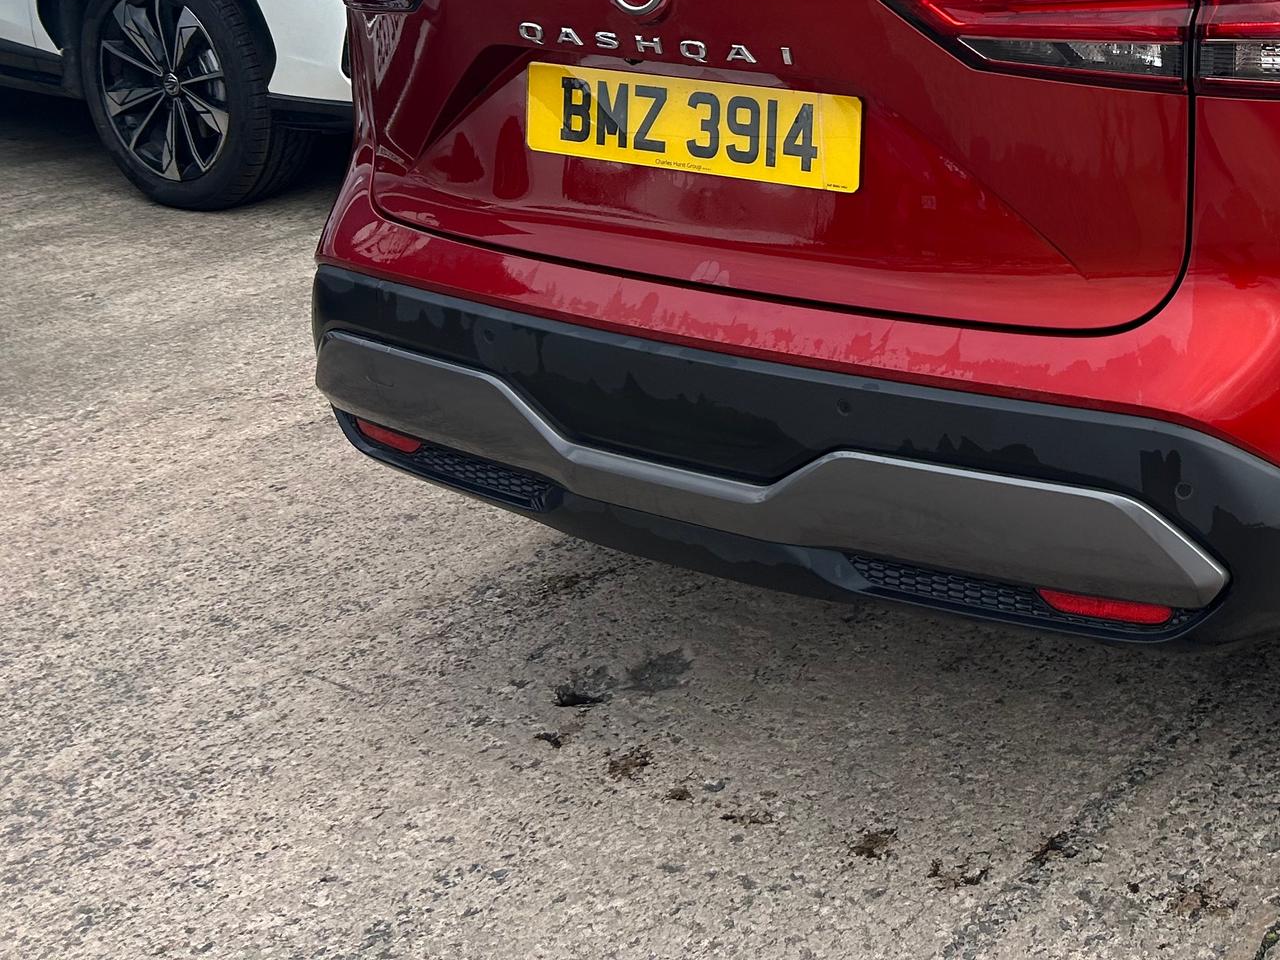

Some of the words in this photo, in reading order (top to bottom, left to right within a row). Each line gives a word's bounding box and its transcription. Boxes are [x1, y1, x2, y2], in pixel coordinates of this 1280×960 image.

[518, 21, 793, 66] QASHQAI
[560, 77, 668, 153] BMZ
[686, 91, 819, 173] 3914
